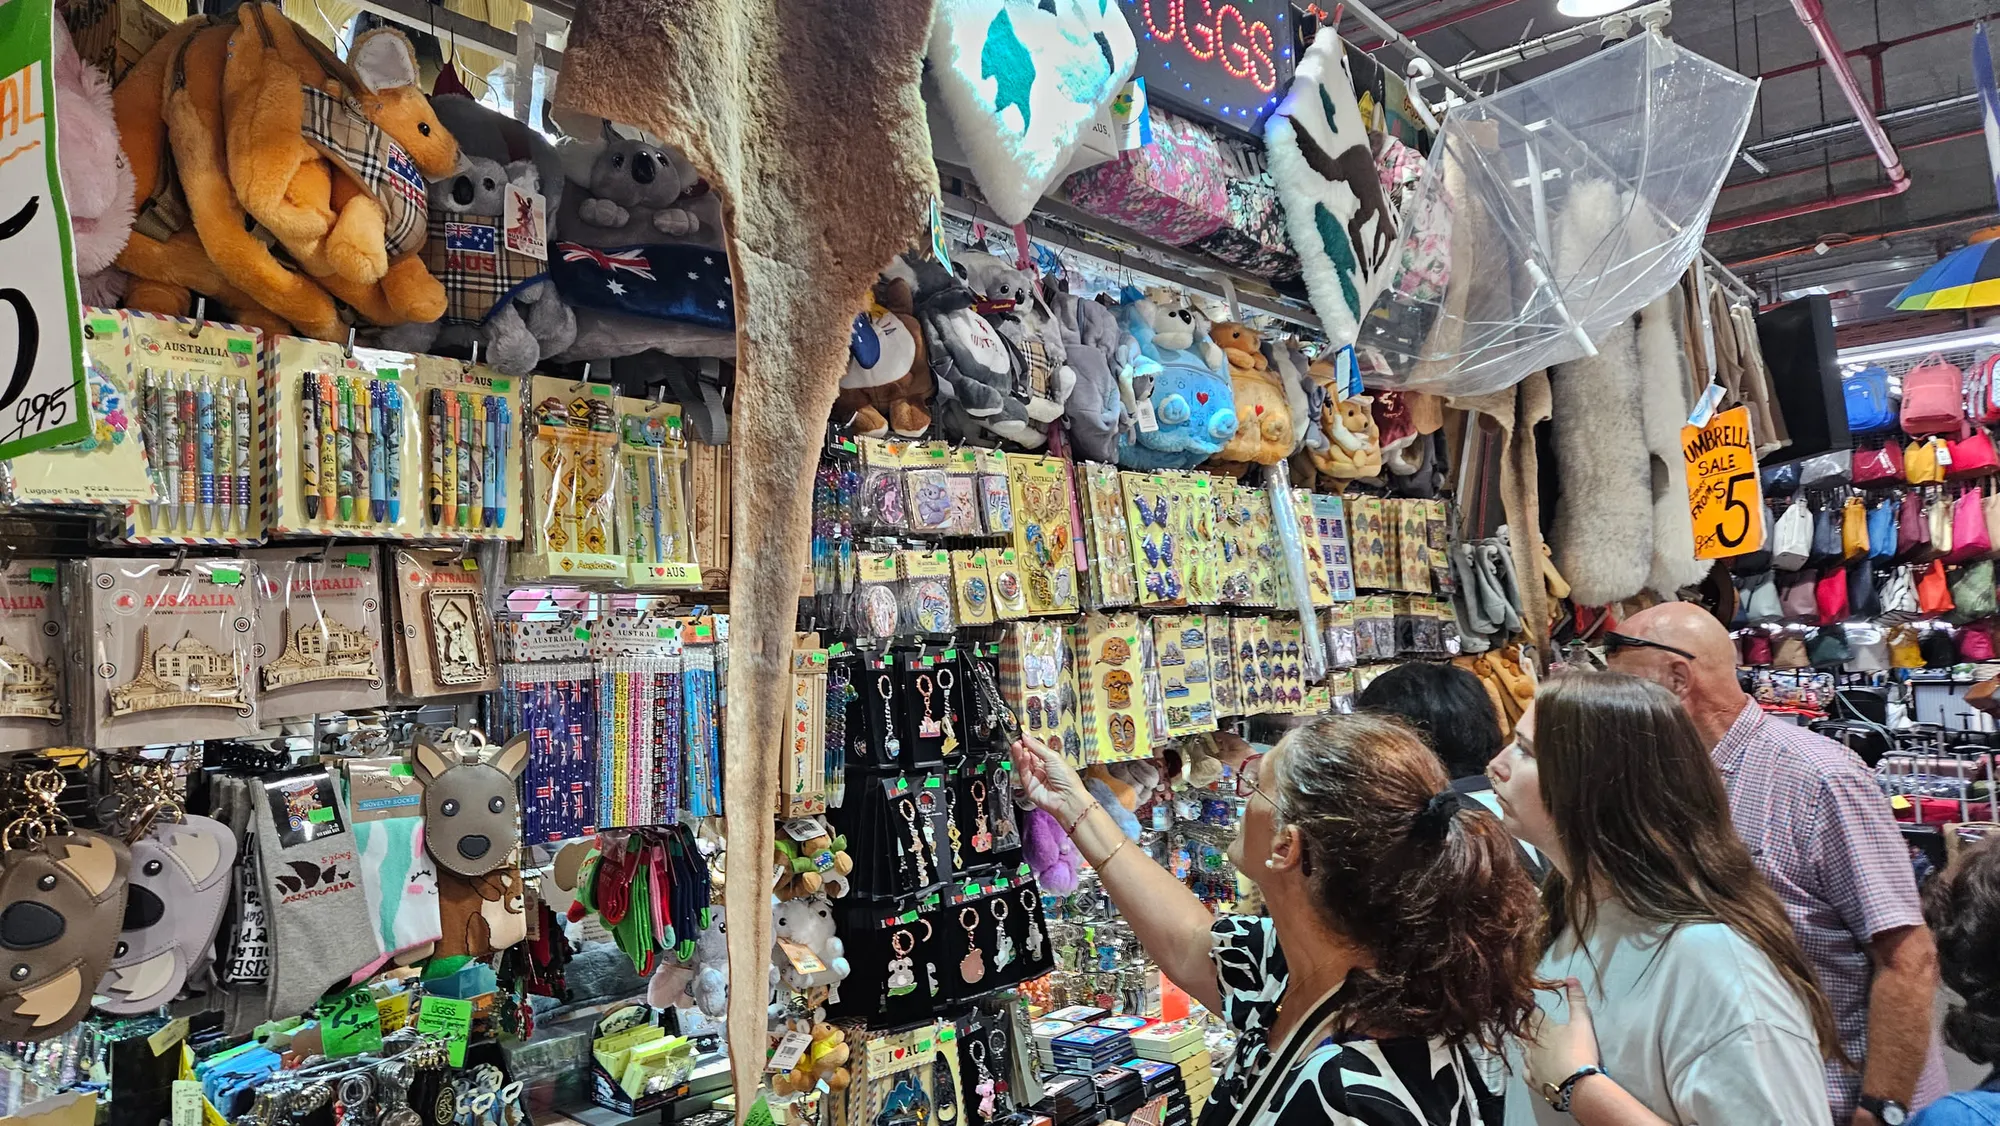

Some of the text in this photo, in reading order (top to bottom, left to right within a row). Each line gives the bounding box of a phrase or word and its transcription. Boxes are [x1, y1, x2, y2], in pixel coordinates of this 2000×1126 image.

[1142, 0, 1276, 93] UGGS
[389, 174, 426, 209] AUS
[448, 255, 496, 272] AUS
[164, 342, 229, 357] AUSTRALIA
[459, 374, 464, 384] I
[1698, 454, 1736, 477] SALE
[24, 487, 80, 496] Luggage Tag
[1691, 485, 1713, 521] FROM
[424, 571, 477, 584] AUSTRALIA
[648, 566, 654, 577] I
[291, 577, 364, 592] AUSTRALIA
[144, 594, 236, 608] AUSTRALIA
[533, 635, 577, 644] AUSTRALIA
[617, 629, 656, 638] AUSTRAL
[131, 691, 197, 712] MELBOURNE
[363, 797, 415, 808] NOVELTY SOCKS
[431, 1003, 457, 1016] UGGS
[888, 1051, 893, 1062] I
